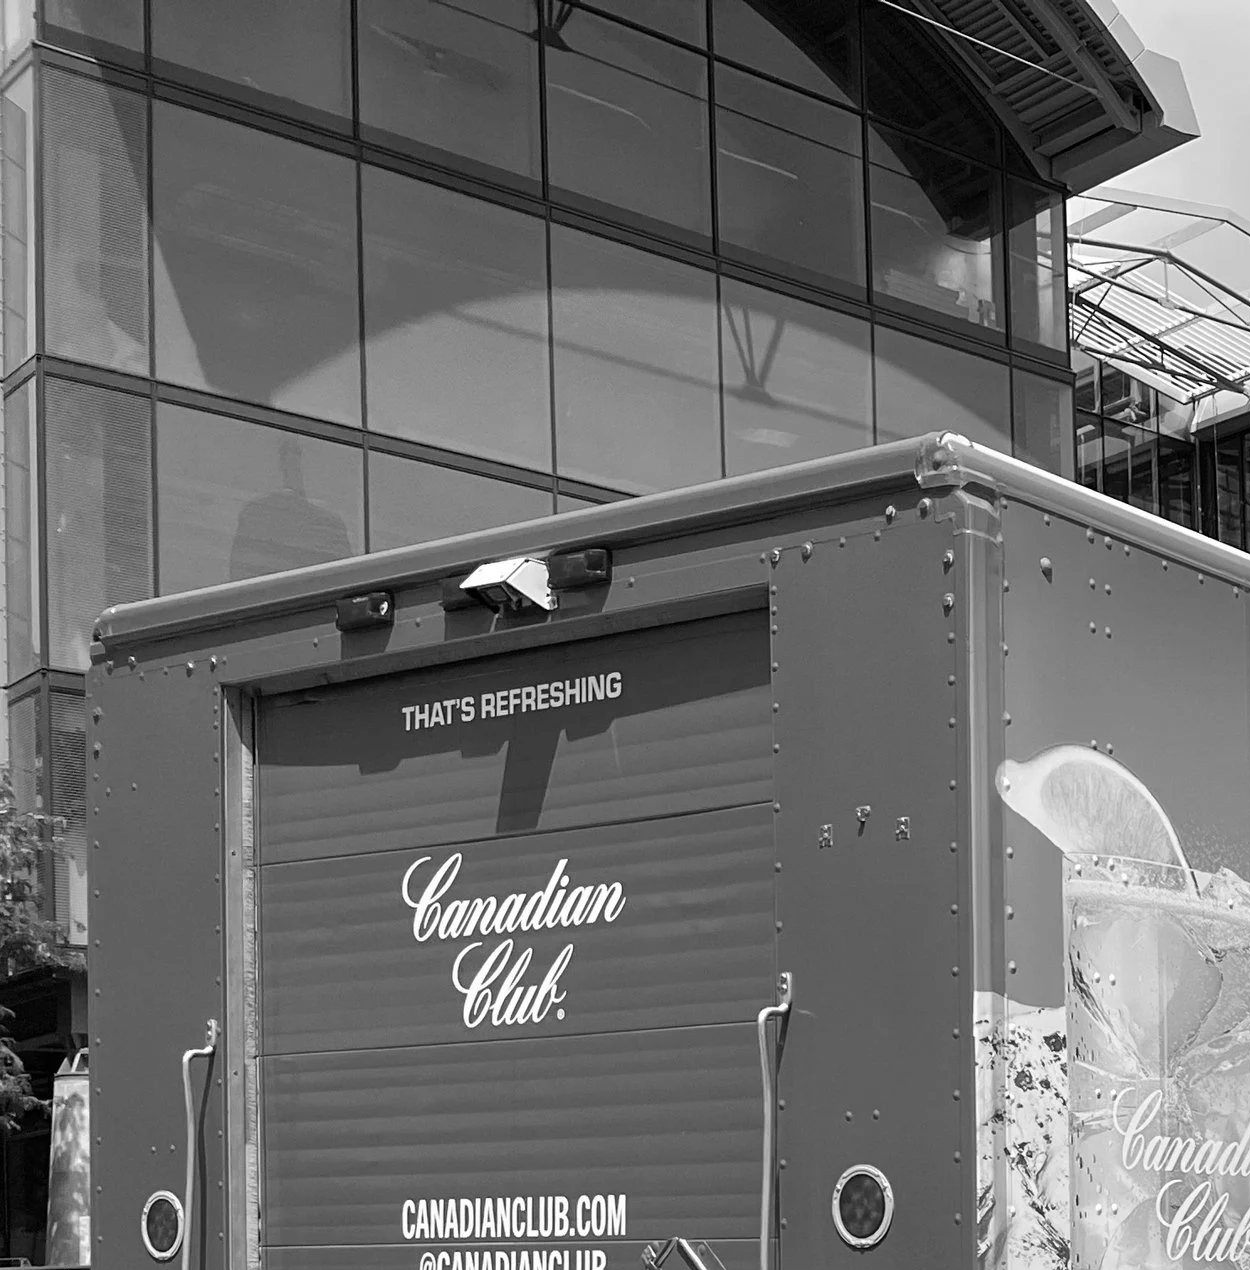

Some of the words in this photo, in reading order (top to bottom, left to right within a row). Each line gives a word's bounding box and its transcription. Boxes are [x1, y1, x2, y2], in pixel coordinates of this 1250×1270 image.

[402, 696, 475, 731] THAT'S
[481, 671, 622, 719] REFRESHING
[402, 853, 627, 942] Canadian
[402, 1194, 627, 1239] CANADIANCLUB.COM
